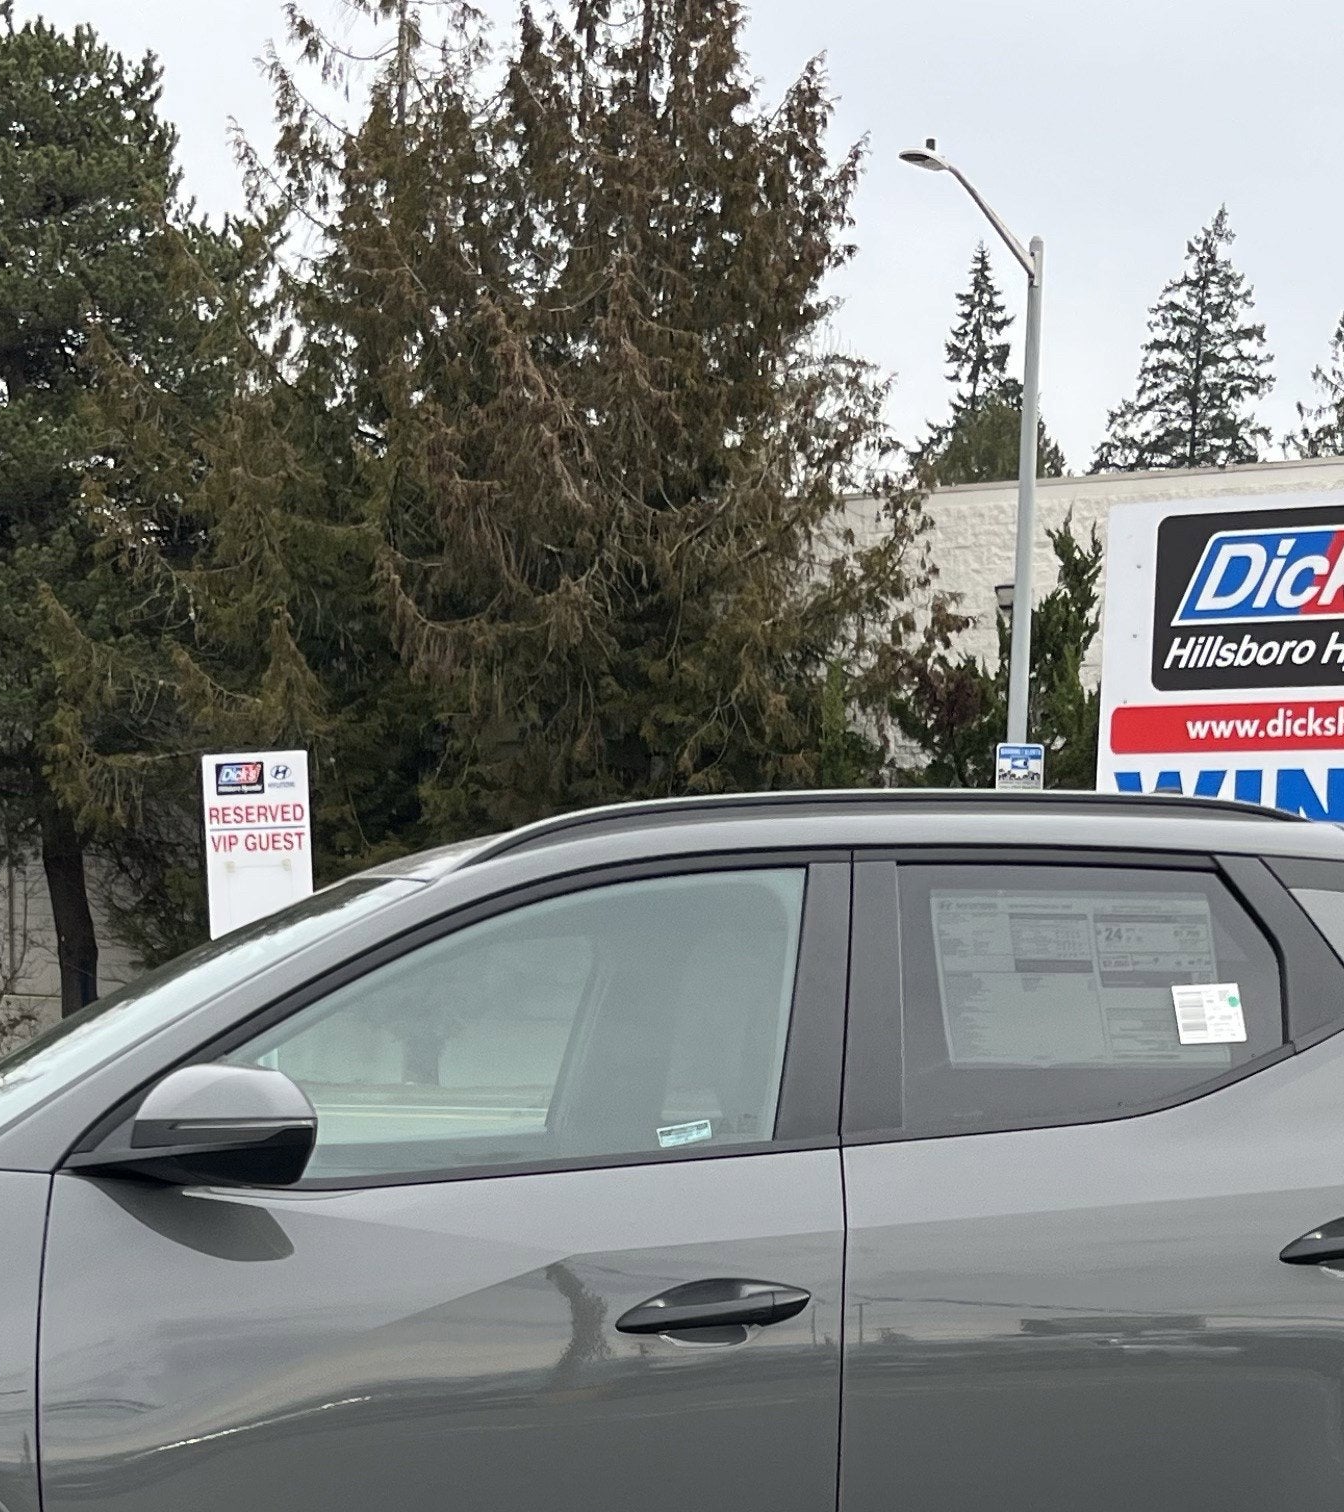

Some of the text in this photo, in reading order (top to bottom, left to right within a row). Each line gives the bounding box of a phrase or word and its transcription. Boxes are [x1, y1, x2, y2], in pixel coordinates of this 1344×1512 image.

[1163, 634, 1316, 669] Hillsboro
[208, 803, 305, 825] RESERVED
[211, 832, 305, 852] VIP GUEST
